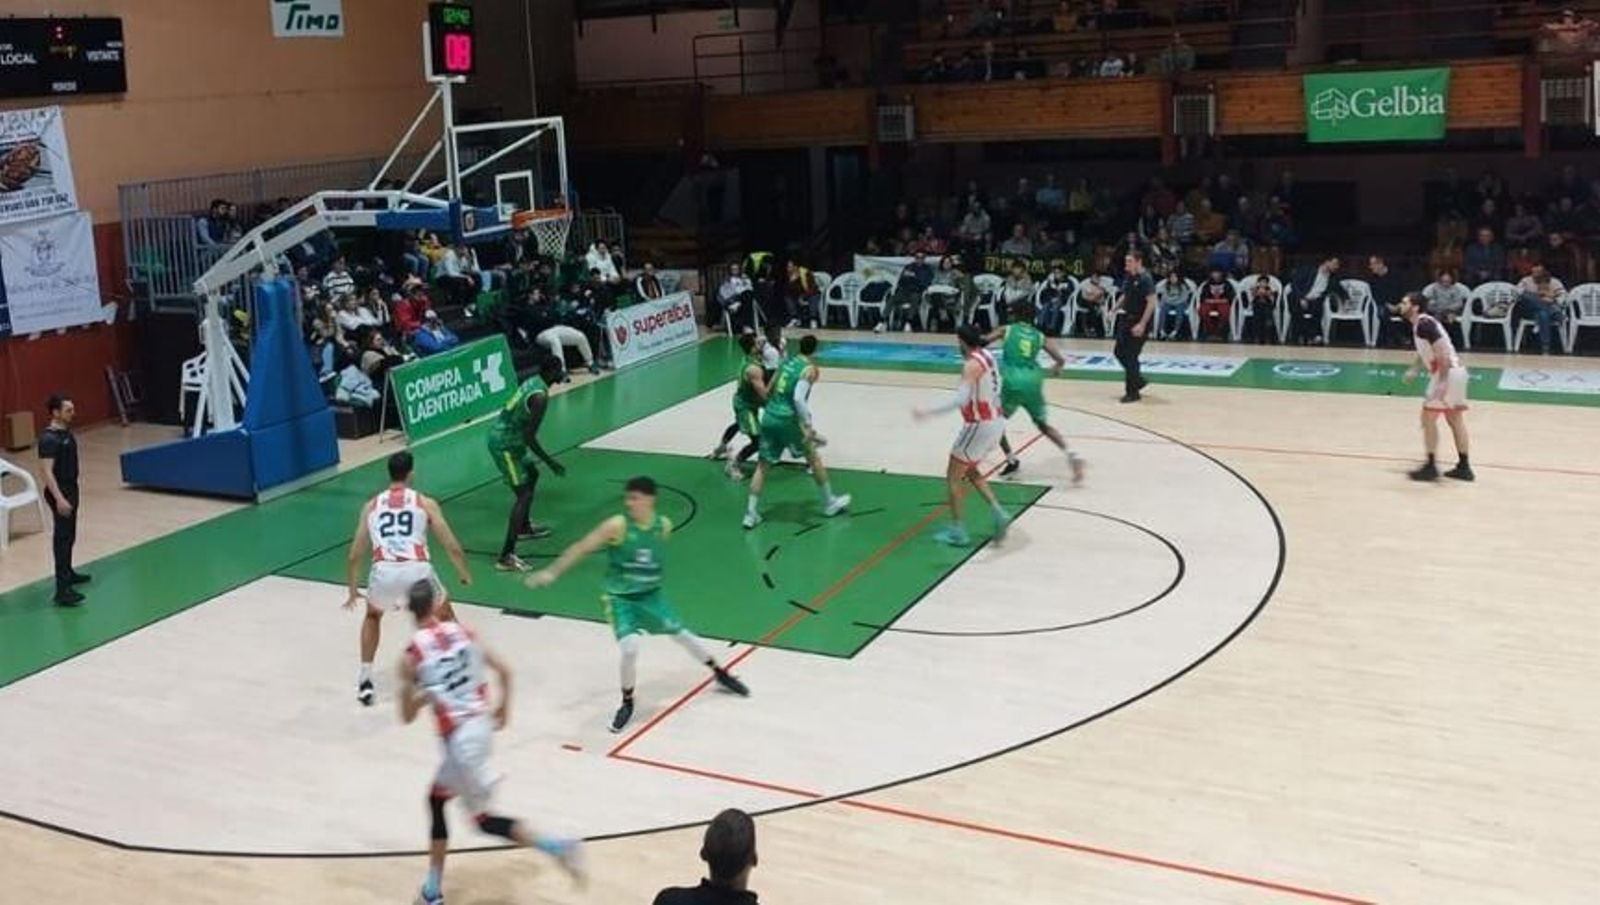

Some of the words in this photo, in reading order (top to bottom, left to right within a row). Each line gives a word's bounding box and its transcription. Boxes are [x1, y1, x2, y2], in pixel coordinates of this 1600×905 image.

[0, 53, 37, 65] LOCAL
[1350, 85, 1445, 117] Gelbia
[405, 366, 462, 401] COMPRA
[408, 382, 484, 424] LAENTRADA
[379, 510, 413, 538] 29
